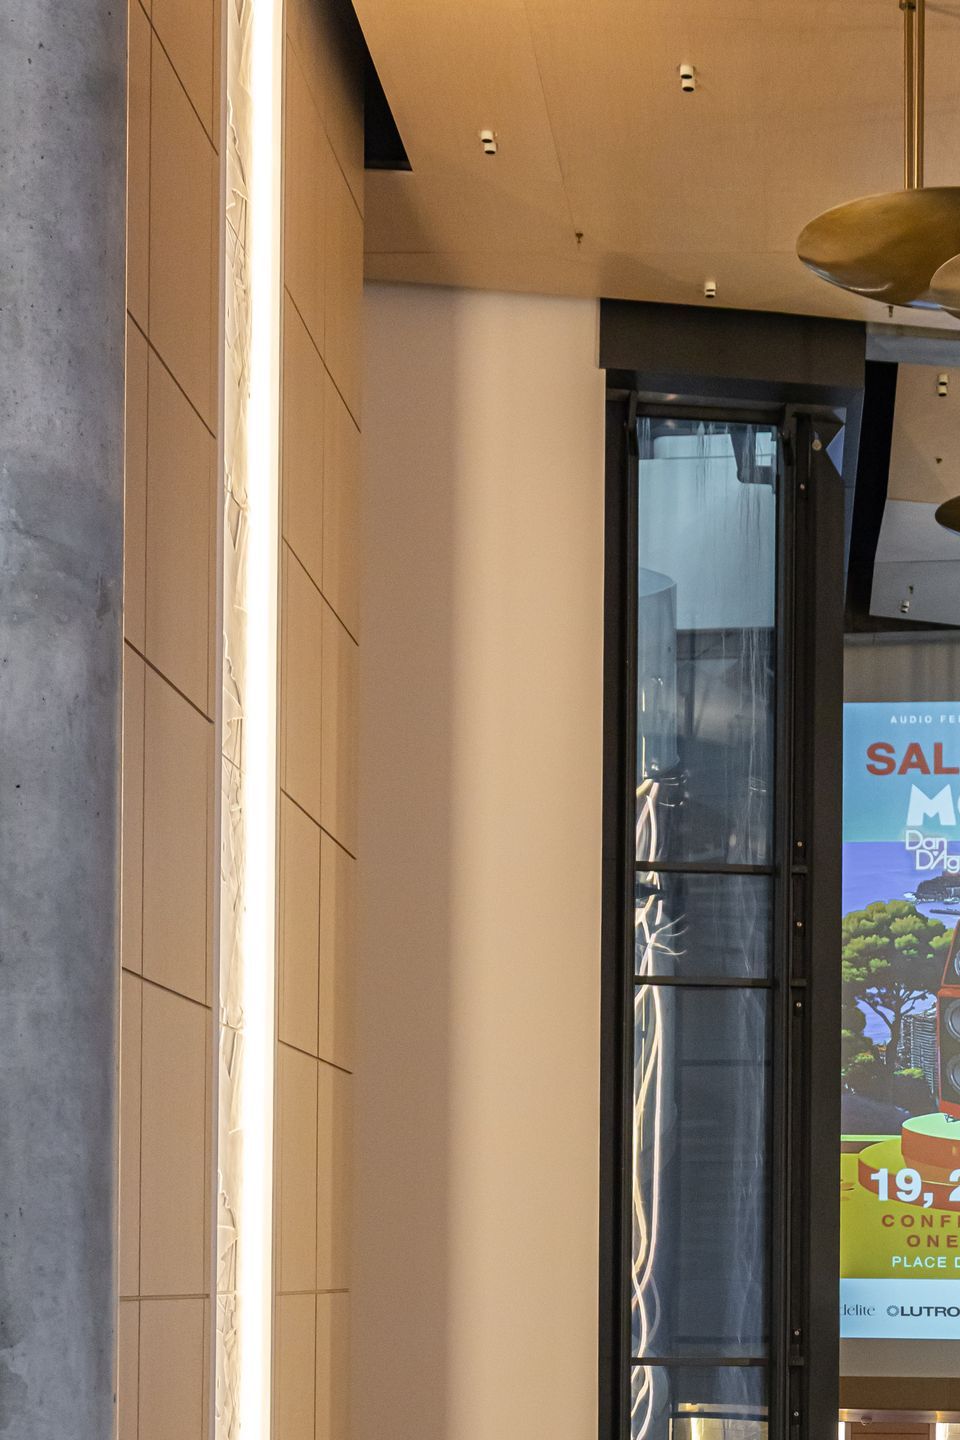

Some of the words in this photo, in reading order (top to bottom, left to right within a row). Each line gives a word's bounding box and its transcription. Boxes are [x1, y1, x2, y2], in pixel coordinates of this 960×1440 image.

[890, 715, 933, 724] AUDIO
[905, 829, 948, 850] Dan
[871, 1168, 934, 1208] 19,
[907, 1234, 959, 1248] ONE
[892, 1256, 947, 1268] PLACE
